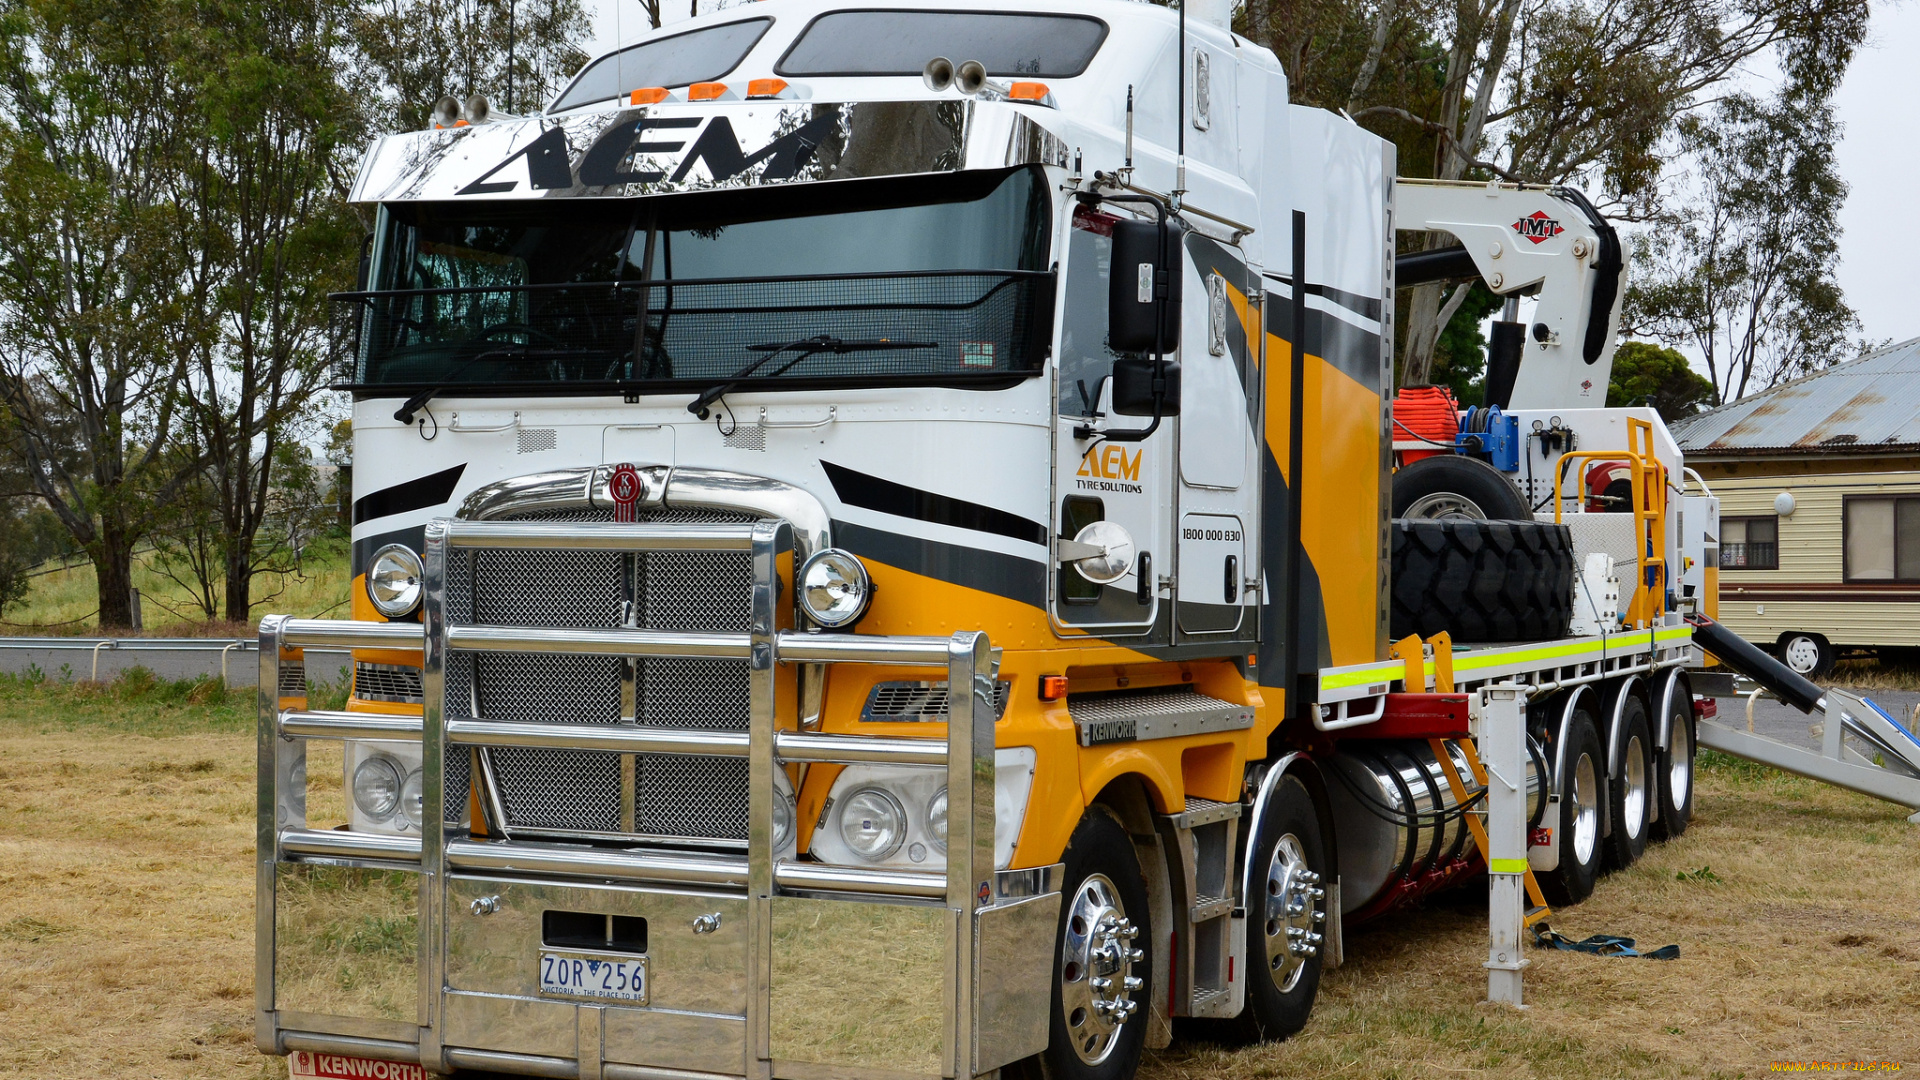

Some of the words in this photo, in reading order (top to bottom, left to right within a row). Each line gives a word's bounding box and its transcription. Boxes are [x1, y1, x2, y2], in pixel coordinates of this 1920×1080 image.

[455, 112, 841, 196] AEM
[1518, 217, 1558, 237] IMT
[1384, 175, 1392, 472] SOLUTIONS
[1076, 445, 1143, 481] AEM
[1076, 480, 1099, 490] TYRE
[1100, 481, 1143, 494] SOLUTIONS
[1183, 528, 1203, 540] 1800
[1206, 530, 1222, 541] 000
[1225, 531, 1240, 541] 830
[1092, 720, 1136, 740] KENWORTH
[544, 958, 583, 987] ZOR
[602, 963, 642, 992] 256
[545, 986, 574, 995] VICTORIA
[584, 989, 595, 997] THE
[599, 990, 618, 998] PLACE
[622, 992, 630, 1000] TO
[318, 1055, 422, 1080] KENWORTH
